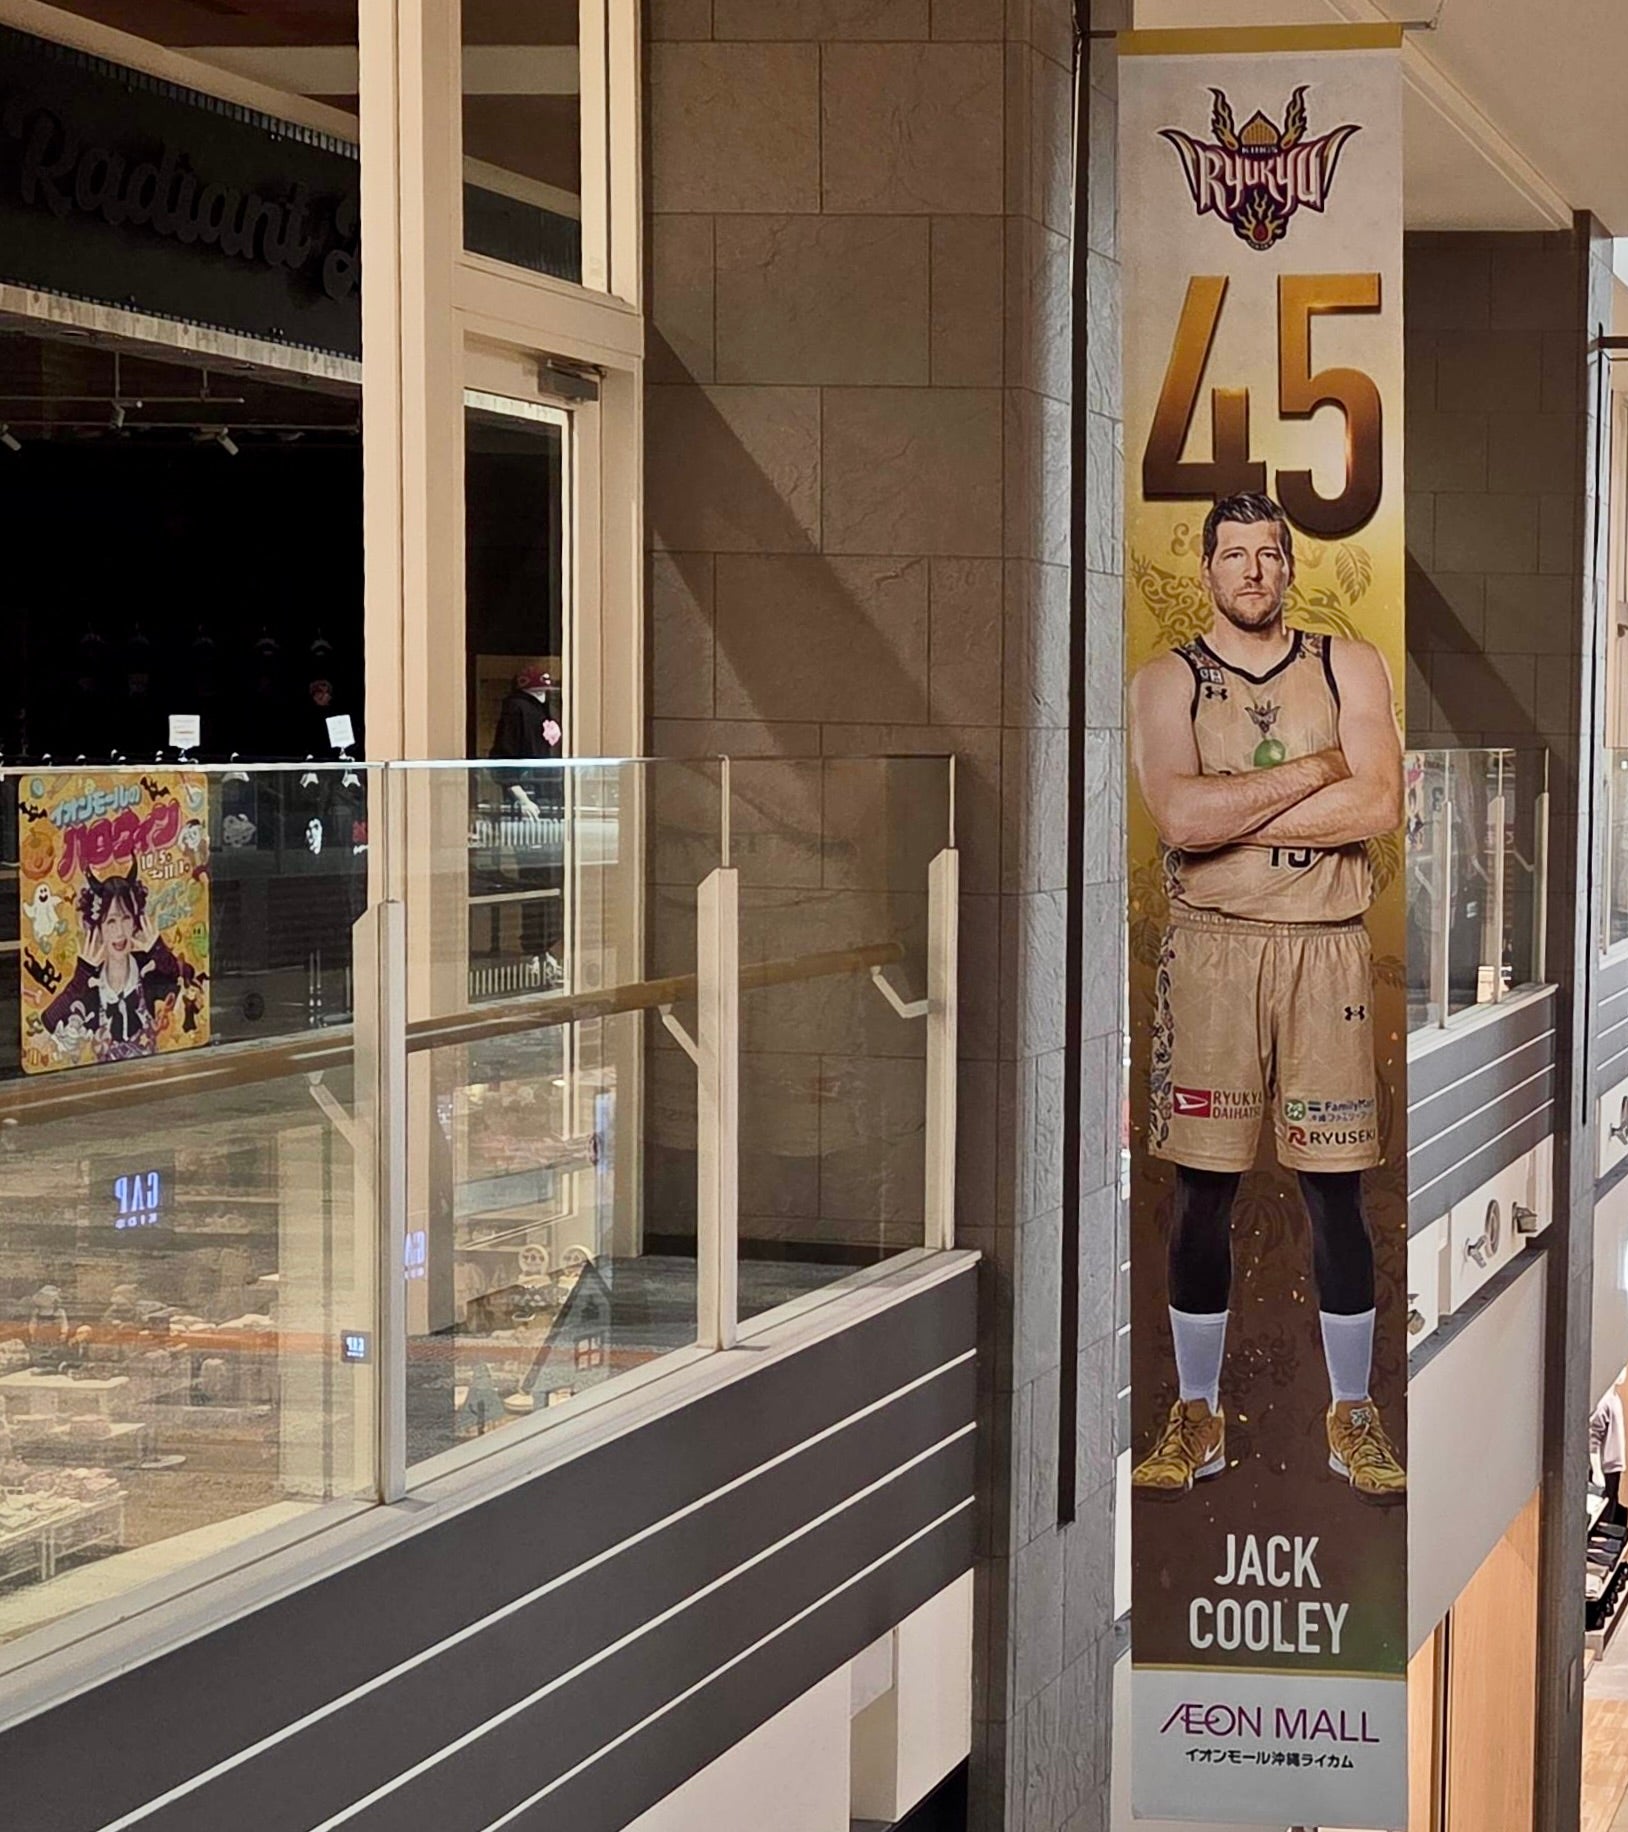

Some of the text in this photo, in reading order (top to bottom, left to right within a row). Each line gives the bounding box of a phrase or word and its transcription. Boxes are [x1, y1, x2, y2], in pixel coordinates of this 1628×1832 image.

[1199, 147, 1324, 213] RYUKYU
[1142, 272, 1383, 539] 45
[1213, 1533, 1322, 1589] JACK
[1188, 1597, 1350, 1655] COOLEY
[1274, 1707, 1381, 1743] MALL
[1185, 1748, 1355, 1769] イオンモール沖縄ライカム
